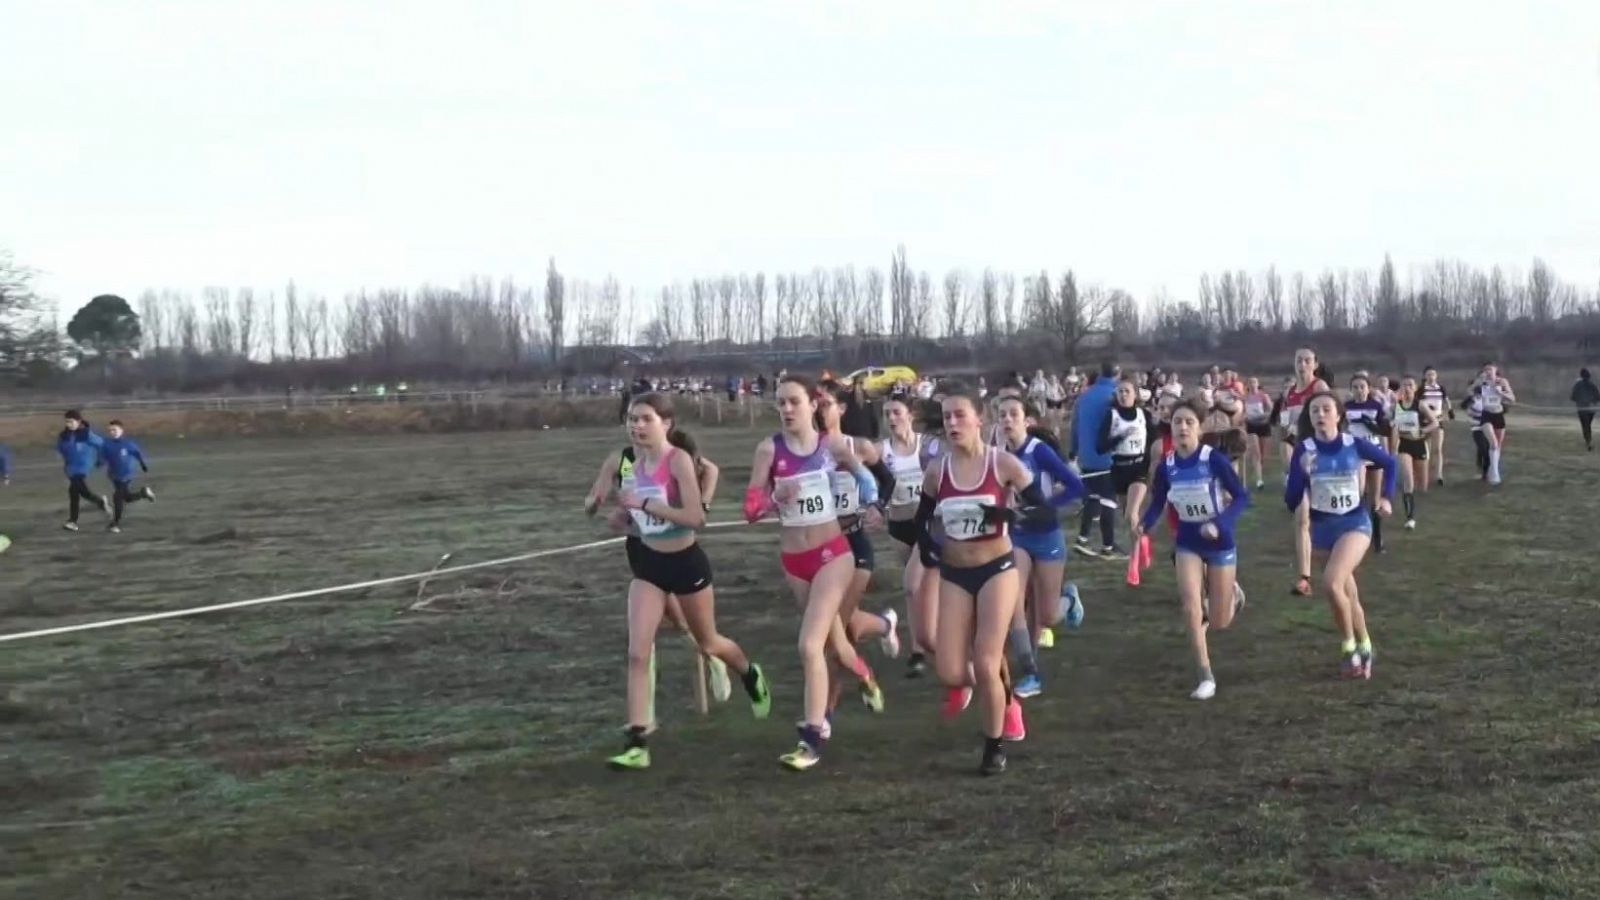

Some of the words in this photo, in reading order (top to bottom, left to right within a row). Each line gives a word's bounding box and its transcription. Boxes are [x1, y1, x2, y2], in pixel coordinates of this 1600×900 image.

[907, 485, 922, 499] 74
[797, 494, 824, 515] 789
[1330, 494, 1352, 509] 815
[1185, 503, 1208, 518] 814
